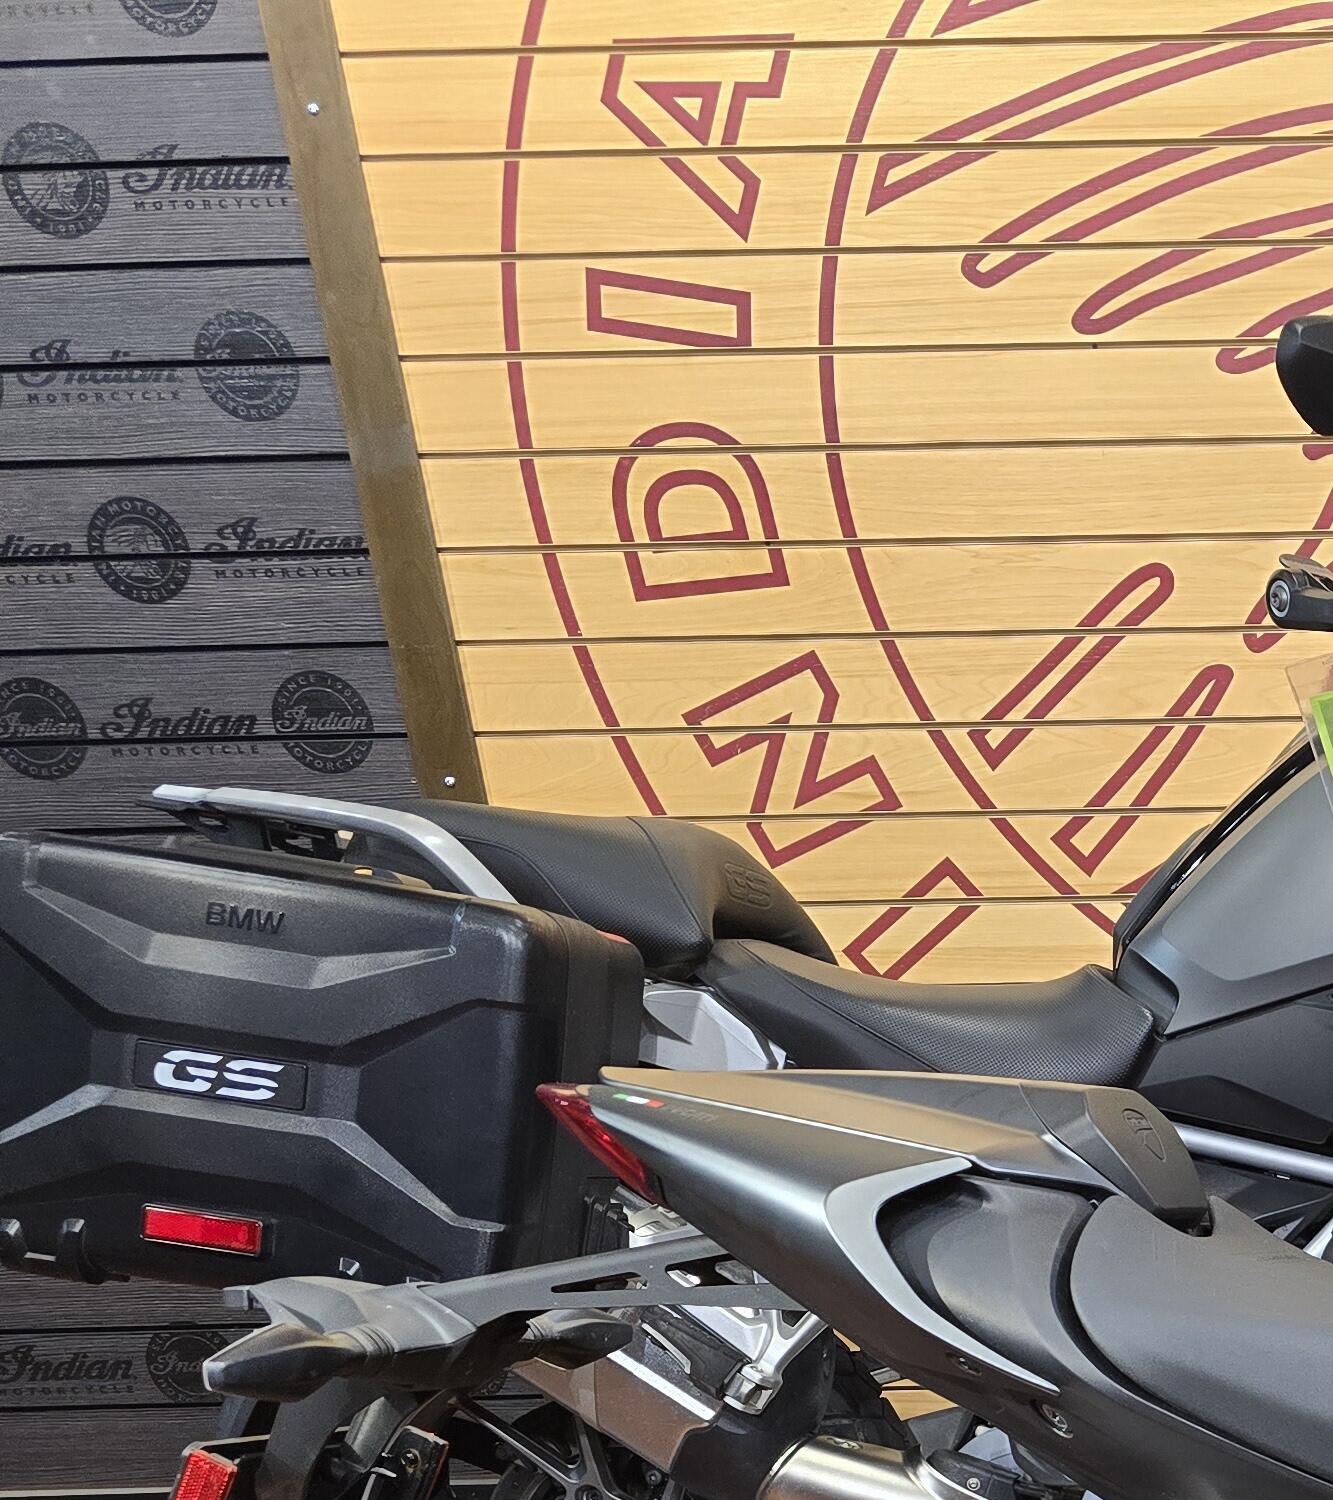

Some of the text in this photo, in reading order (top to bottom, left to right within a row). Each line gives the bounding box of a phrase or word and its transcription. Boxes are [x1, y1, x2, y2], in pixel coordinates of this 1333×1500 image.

[134, 197, 289, 211] MOTORCYCLE
[27, 391, 181, 404] MOTORCYCLE
[0, 535, 73, 567] dian
[204, 517, 366, 563] Indian
[6, 573, 74, 584] CYCLE
[216, 568, 364, 579] MOTORCYCLE
[100, 697, 258, 739] Indian
[276, 705, 368, 733] Indian
[111, 745, 258, 756] MOTORCYCLE
[206, 902, 286, 935] BMW
[153, 1049, 285, 1100] GS
